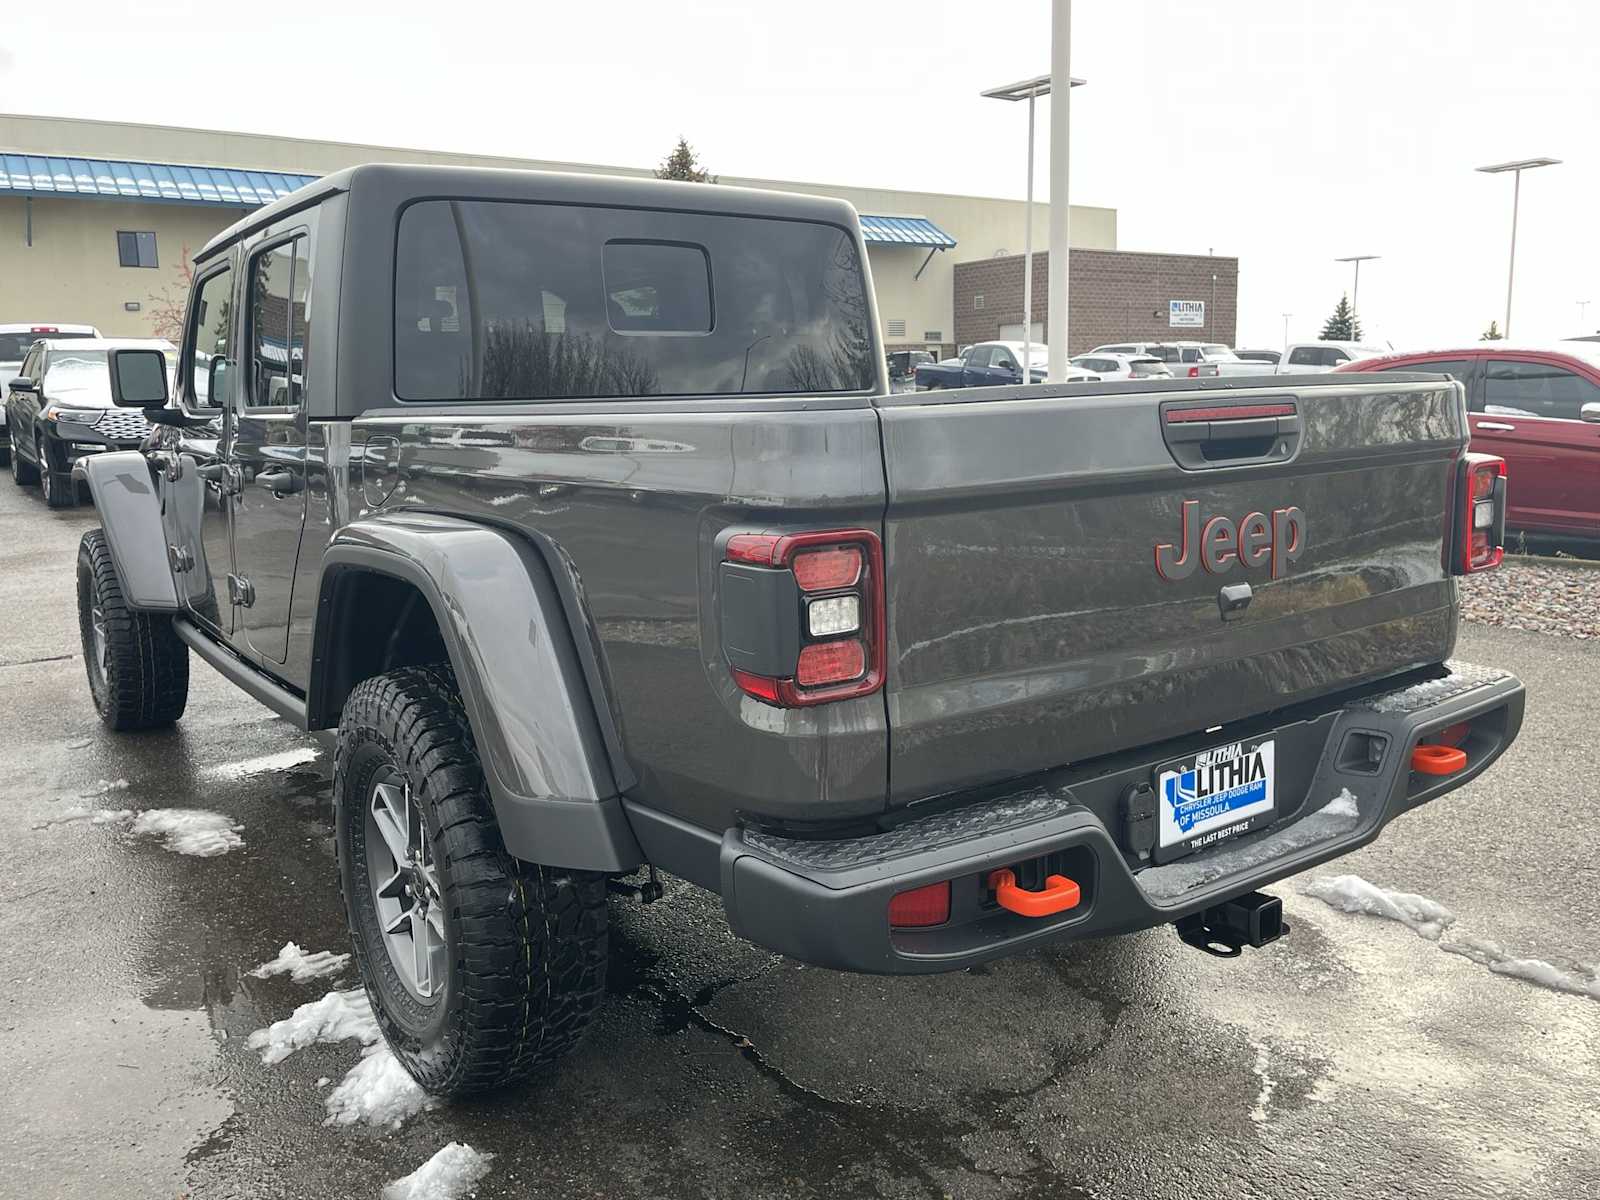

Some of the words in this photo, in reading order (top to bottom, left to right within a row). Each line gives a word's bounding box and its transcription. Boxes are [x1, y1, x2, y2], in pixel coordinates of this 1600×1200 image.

[1178, 302, 1203, 312] LITHIA
[1155, 500, 1306, 581] Jeep
[1206, 743, 1243, 766] LITHIA
[1197, 752, 1266, 798] LITHIA
[1180, 795, 1211, 815] CHRYSLER
[1213, 792, 1227, 804] JEEP
[1228, 786, 1249, 799] DODGE
[1249, 782, 1263, 792] RAM
[1180, 815, 1191, 826] OF
[1192, 802, 1230, 822] MISSOULA
[1191, 837, 1202, 848] THE
[1202, 832, 1217, 844] LAST
[1217, 828, 1232, 840] BEST
[1232, 822, 1249, 835] PRICE
